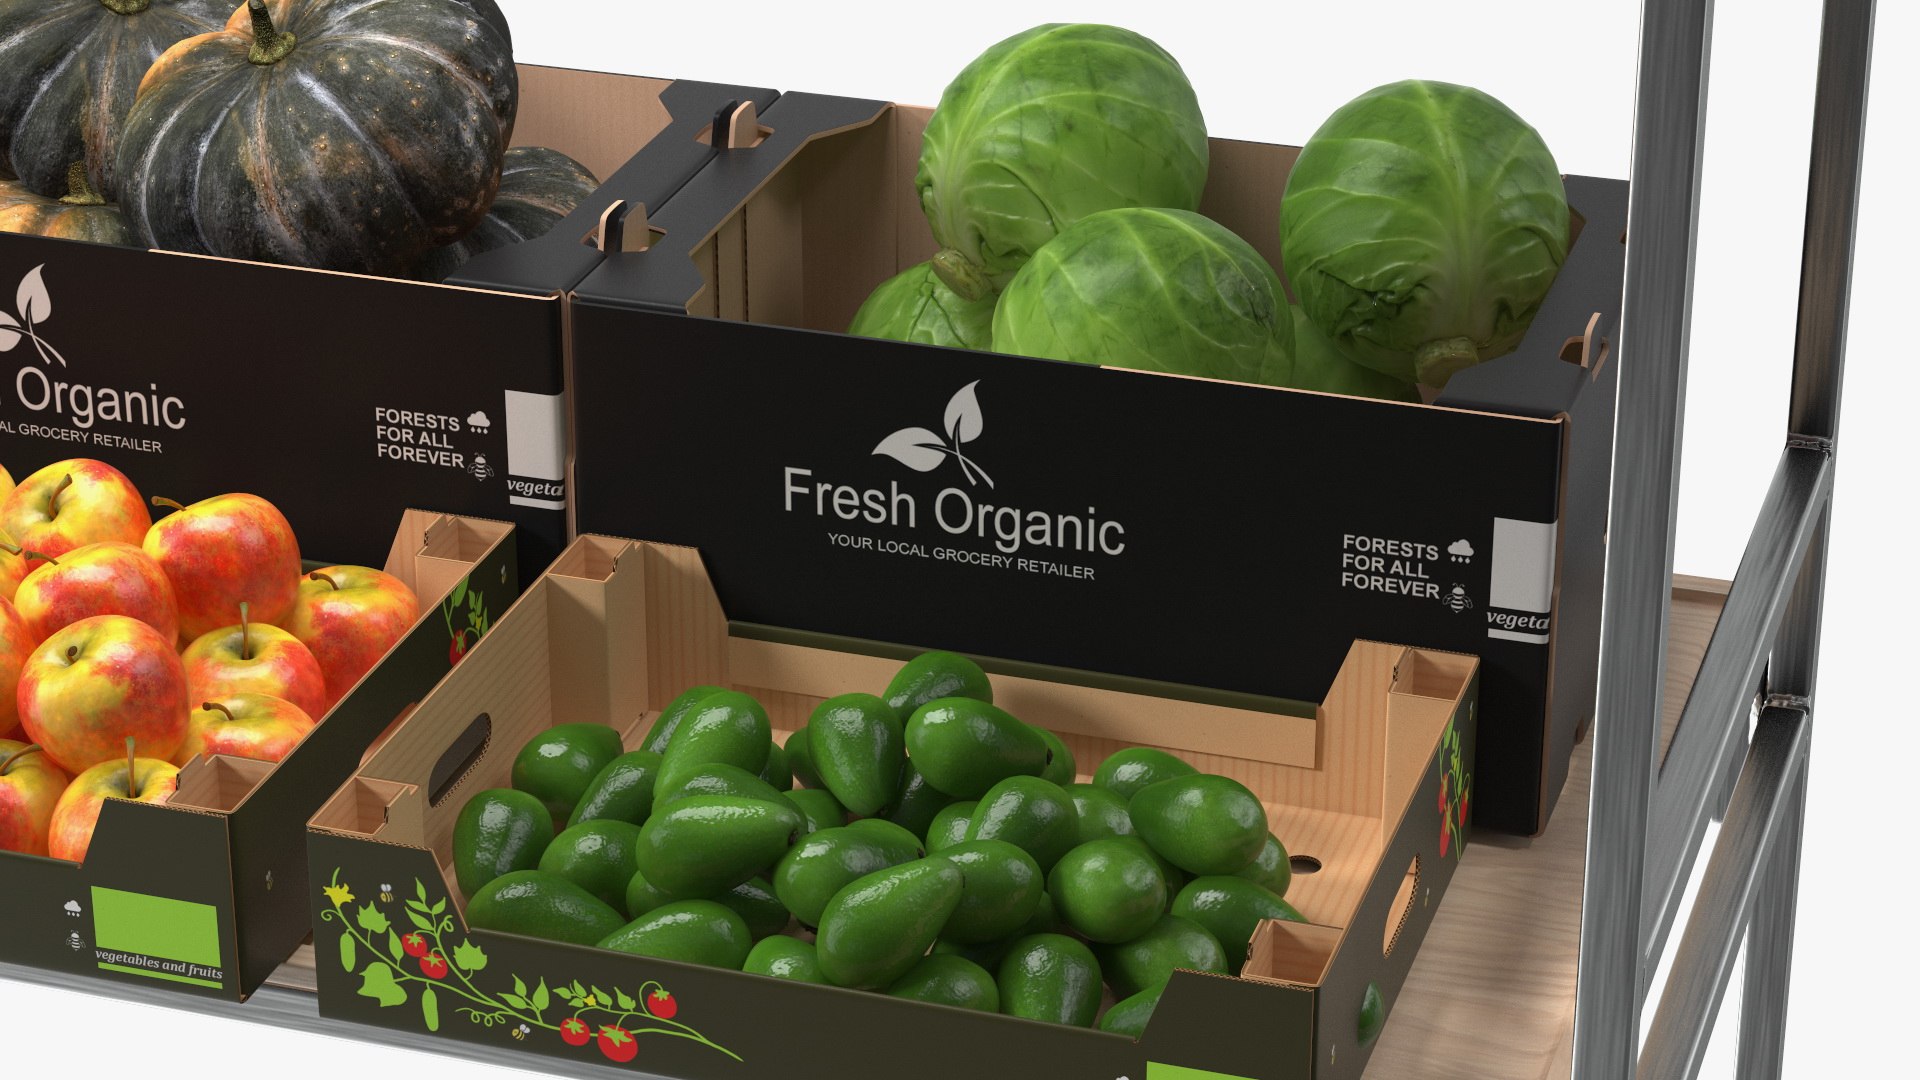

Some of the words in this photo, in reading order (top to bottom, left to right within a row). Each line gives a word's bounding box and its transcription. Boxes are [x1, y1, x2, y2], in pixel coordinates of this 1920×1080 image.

[16, 366, 186, 430] Organic
[375, 407, 460, 432] FORESTS
[18, 423, 89, 443] GROCERY
[93, 433, 162, 453] RETAILER
[376, 425, 414, 443] FOR
[419, 432, 454, 449] ALL
[377, 443, 465, 468] FOREVER
[785, 466, 916, 528] Fresh
[933, 487, 1125, 555] Organic
[828, 532, 873, 550] YOUR
[878, 539, 930, 558] LOCAL
[933, 547, 1013, 569] GROCERY
[1017, 558, 1095, 580] RETAILER
[1343, 534, 1439, 561] FORESTS
[1342, 553, 1385, 573] FOR
[1390, 560, 1430, 579] ALL
[1341, 572, 1440, 599] FOREVER
[95, 950, 160, 969] vegetables
[162, 960, 186, 973] and
[187, 964, 223, 979] fruits
